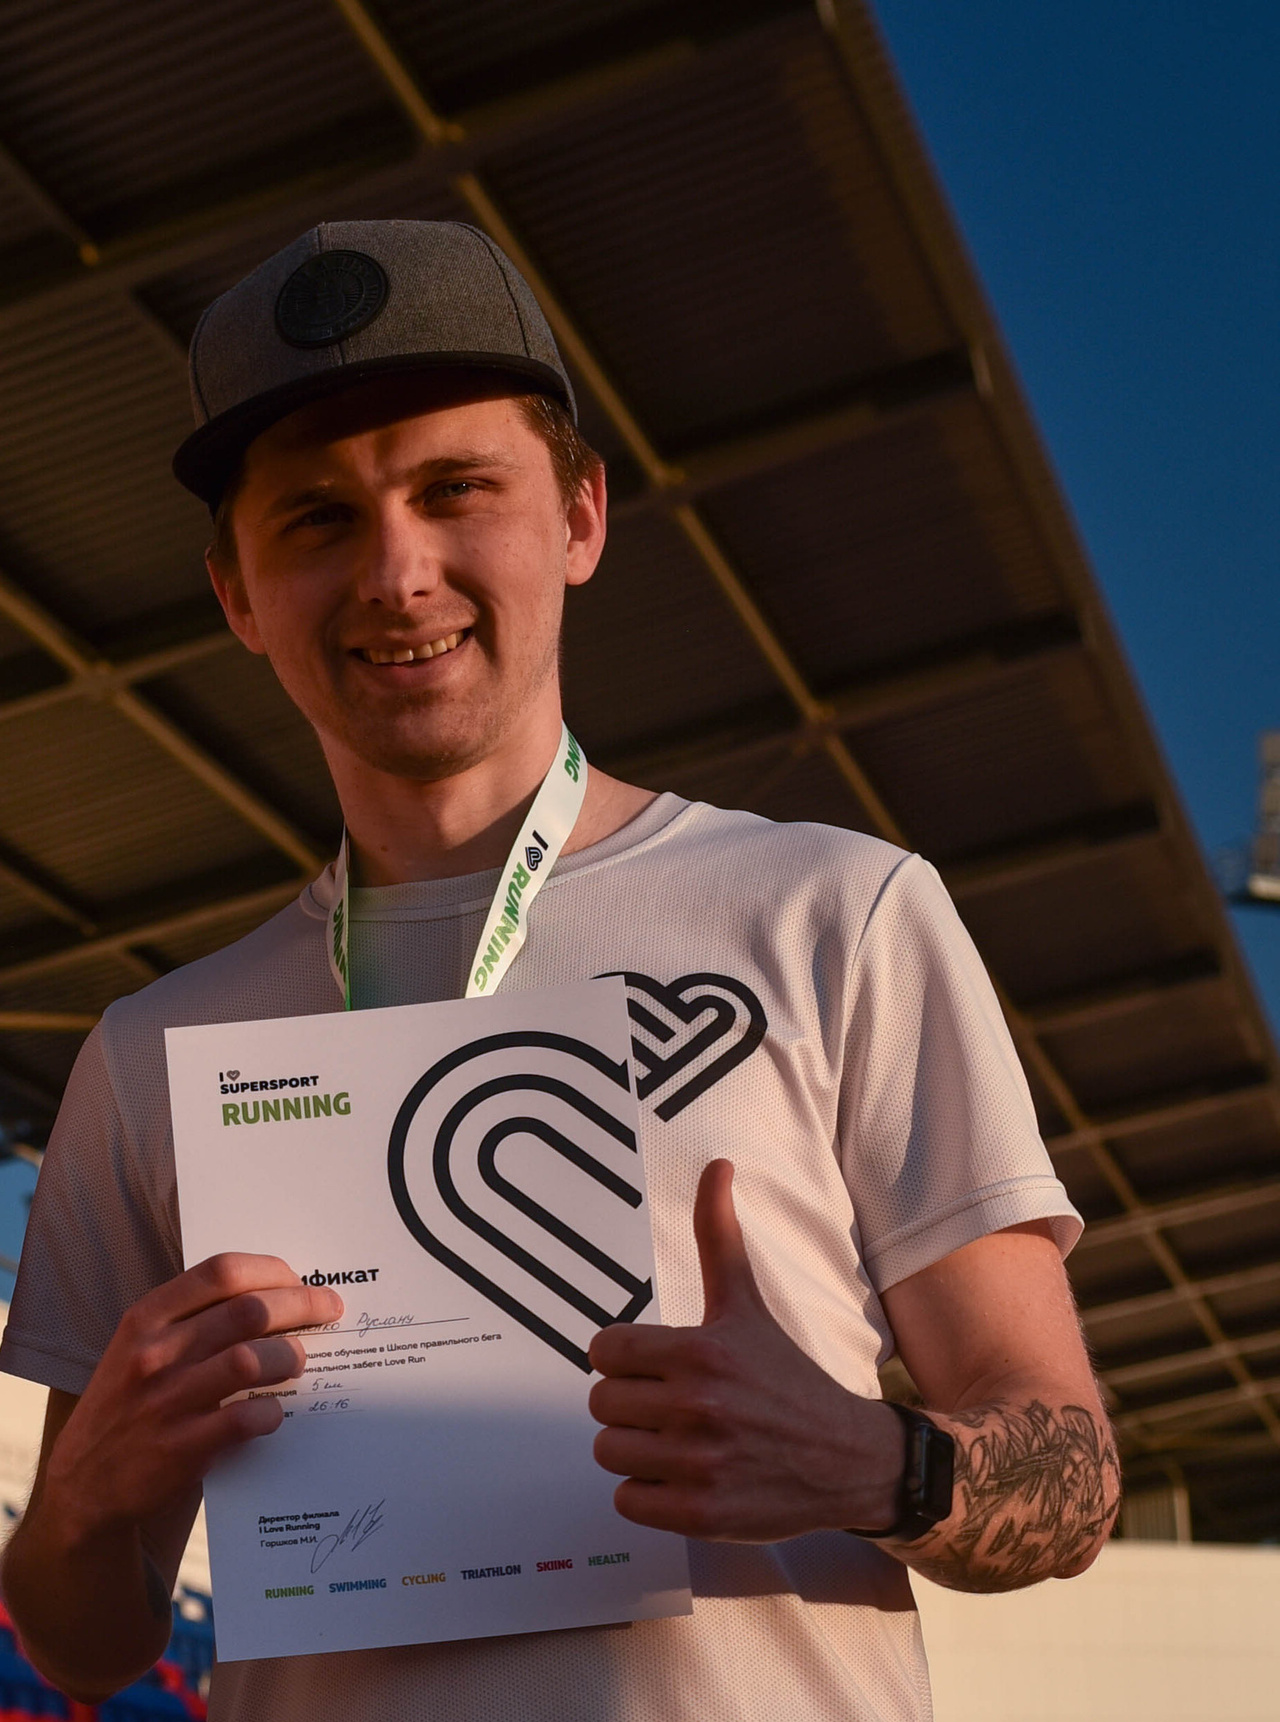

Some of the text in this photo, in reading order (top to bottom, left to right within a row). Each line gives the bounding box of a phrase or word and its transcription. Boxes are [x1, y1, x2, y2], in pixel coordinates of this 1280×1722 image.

[474, 829, 549, 992] I RUNNING
[218, 1071, 225, 1083] I
[219, 1074, 320, 1095] SUPERSPORT
[221, 1091, 352, 1126] RUNNING
[301, 1268, 380, 1287] фикат
[305, 1351, 333, 1360] шное
[334, 1346, 378, 1358] обучение
[386, 1343, 419, 1353] Школе
[420, 1336, 480, 1350] правильного
[481, 1332, 503, 1343] бега
[303, 1355, 426, 1374] инальном забеге Love Run
[248, 1389, 298, 1400] Дистанция
[312, 1378, 324, 1392] 5
[259, 1511, 340, 1525] Директор филиала
[264, 1525, 284, 1534] Love
[285, 1522, 321, 1532] Running
[260, 1537, 299, 1548] Горшков
[265, 1552, 630, 1600] RUNNING SWIMMING CYCLING TRIATHLON SKIING HEALTH
